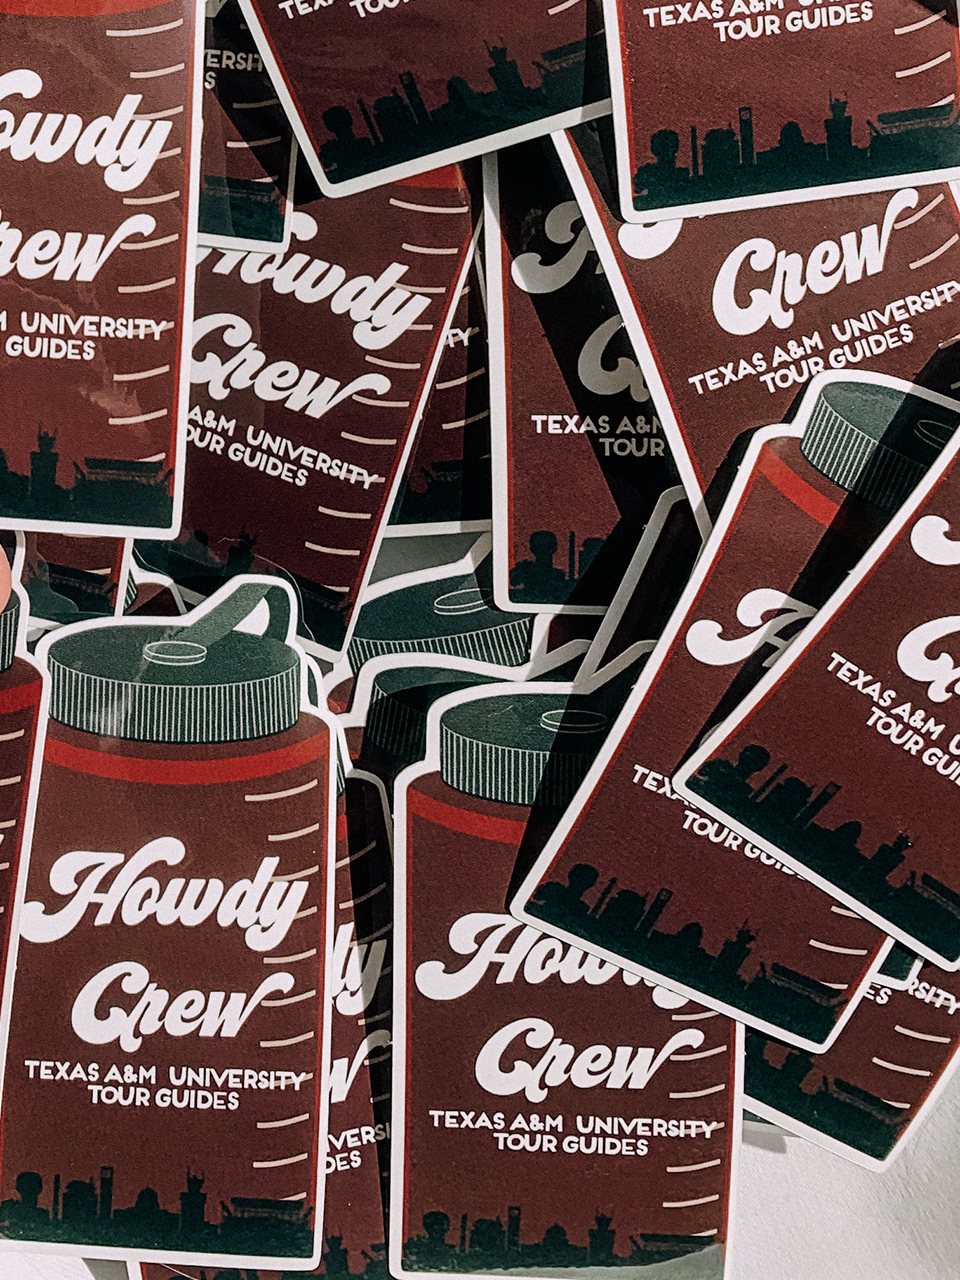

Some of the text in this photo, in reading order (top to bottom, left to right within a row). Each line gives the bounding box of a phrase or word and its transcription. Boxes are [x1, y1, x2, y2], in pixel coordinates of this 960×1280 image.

[712, 1, 874, 43] TOUR GUIDES
[712, 188, 919, 336] Crew
[5, 336, 96, 361] GUIDES
[20, 311, 167, 341] UNIVERSITY
[190, 313, 392, 420] Crew
[688, 352, 767, 395] TEXAS
[771, 332, 825, 370] A&M
[759, 323, 914, 394] TOUR GUIDES
[187, 405, 379, 491] A&M UNIVERSITY
[531, 414, 611, 434] TEXAS
[599, 437, 665, 457] TOUR
[185, 426, 310, 487] OUR GUIDES
[827, 651, 897, 707] TEXAS
[890, 702, 946, 741] A&M
[866, 706, 925, 756] TOUR
[682, 810, 742, 851] TOUR
[20, 837, 309, 951] Howdy
[71, 961, 295, 1053] Crew
[24, 1059, 306, 1091] TEXAS A&M UNIVERSITY
[476, 1018, 705, 1102] Crew
[87, 1084, 240, 1111] TOUR GUIDES
[429, 1109, 717, 1140] TEXAS A&M UNIVERSITY
[493, 1131, 649, 1156] TOUR GUIDES
